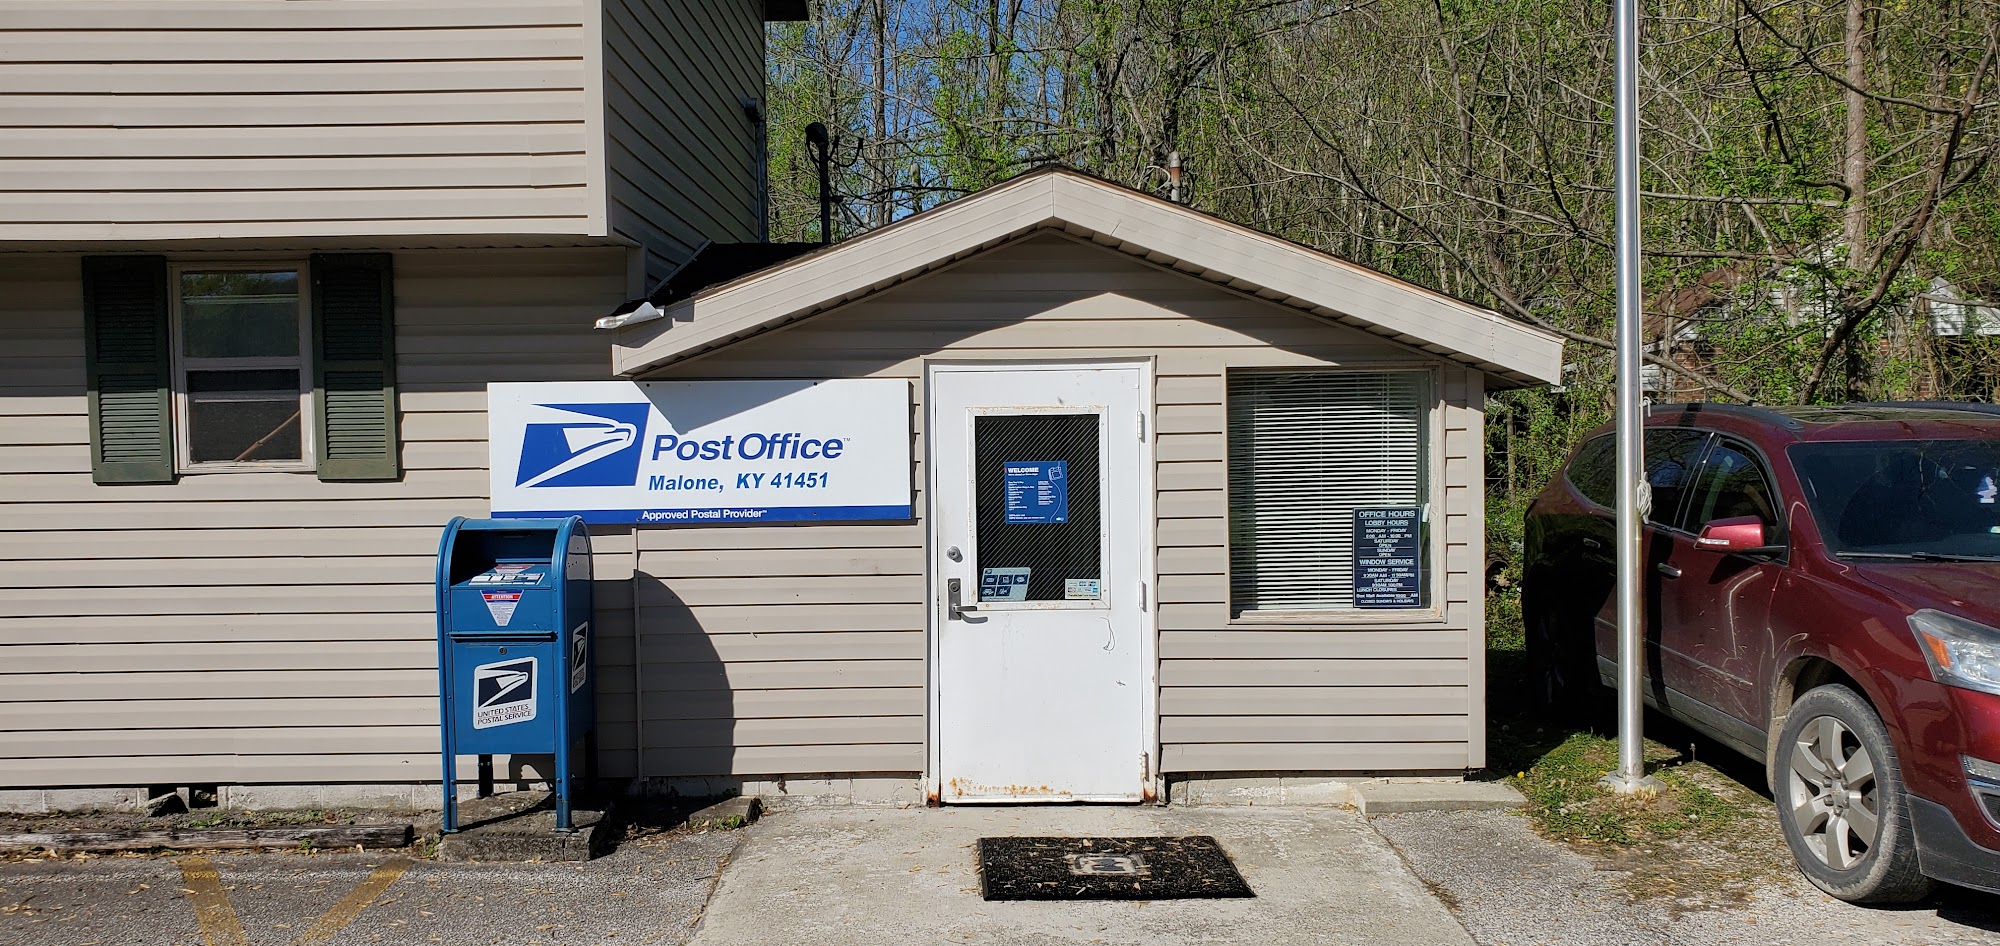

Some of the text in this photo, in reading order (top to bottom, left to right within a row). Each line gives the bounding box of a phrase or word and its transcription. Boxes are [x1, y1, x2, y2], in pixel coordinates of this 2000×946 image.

[652, 434, 734, 461] Post
[648, 472, 829, 493] Malone, KY 41451
[642, 509, 689, 521] Approved
[691, 510, 721, 519] Postal
[477, 704, 529, 718] UNITED STATES
[477, 710, 531, 725] POSTAL SERVICE
